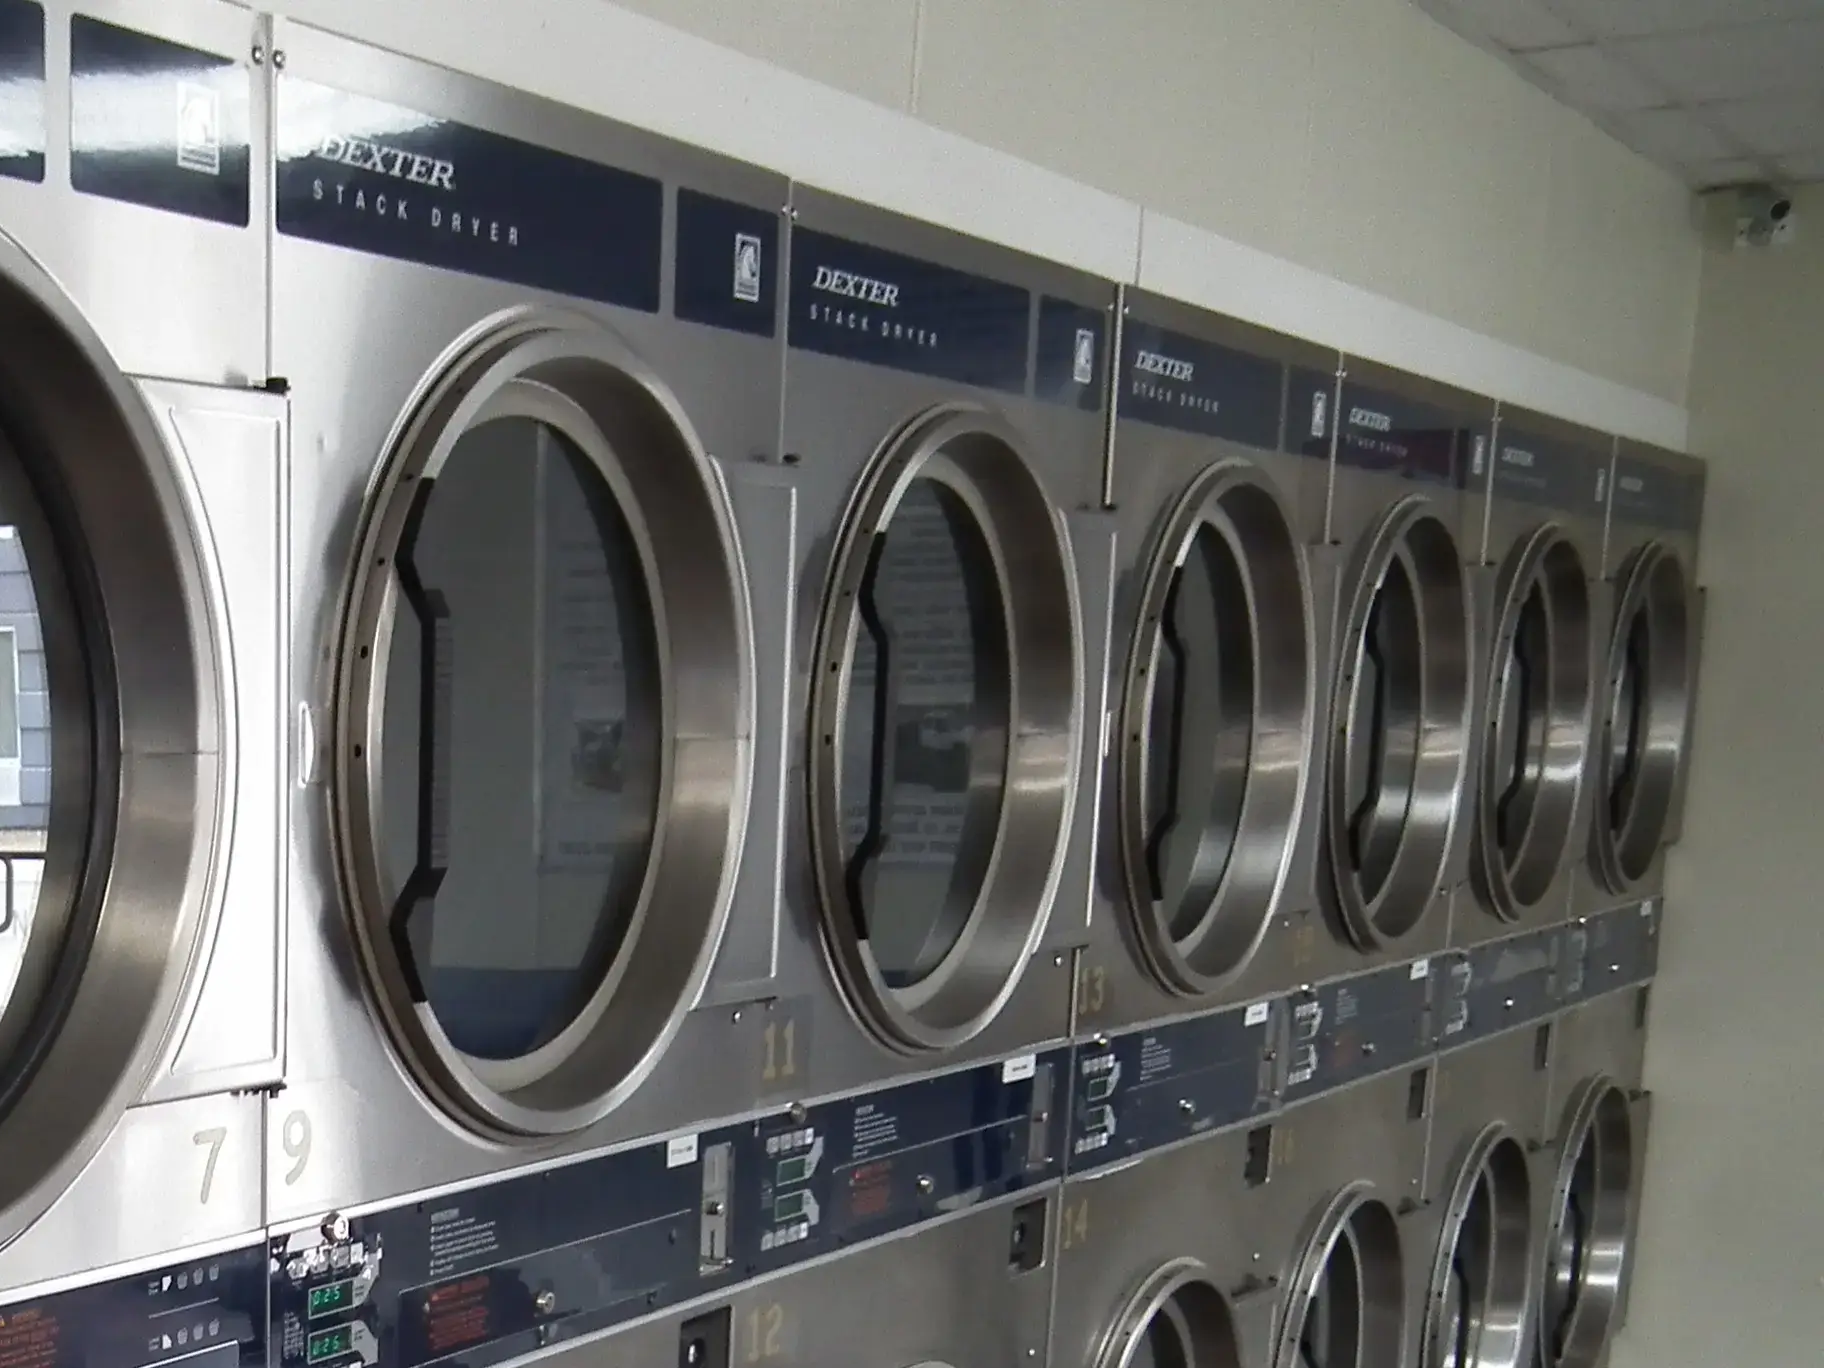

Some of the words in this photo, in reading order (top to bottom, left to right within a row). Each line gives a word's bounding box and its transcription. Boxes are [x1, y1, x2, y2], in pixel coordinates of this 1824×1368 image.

[313, 134, 457, 190] DEXTER
[313, 178, 408, 220] STACK
[431, 206, 518, 246] DRYER
[813, 265, 900, 307] DEXTER
[810, 304, 869, 331] STACK
[881, 320, 937, 348] DRYER
[1134, 351, 1194, 382] DEXTER
[1079, 966, 1105, 1015] 13
[762, 1019, 795, 1081] 11
[193, 1126, 227, 1205] 7
[283, 1109, 312, 1186] 9
[747, 1304, 784, 1363] 12
